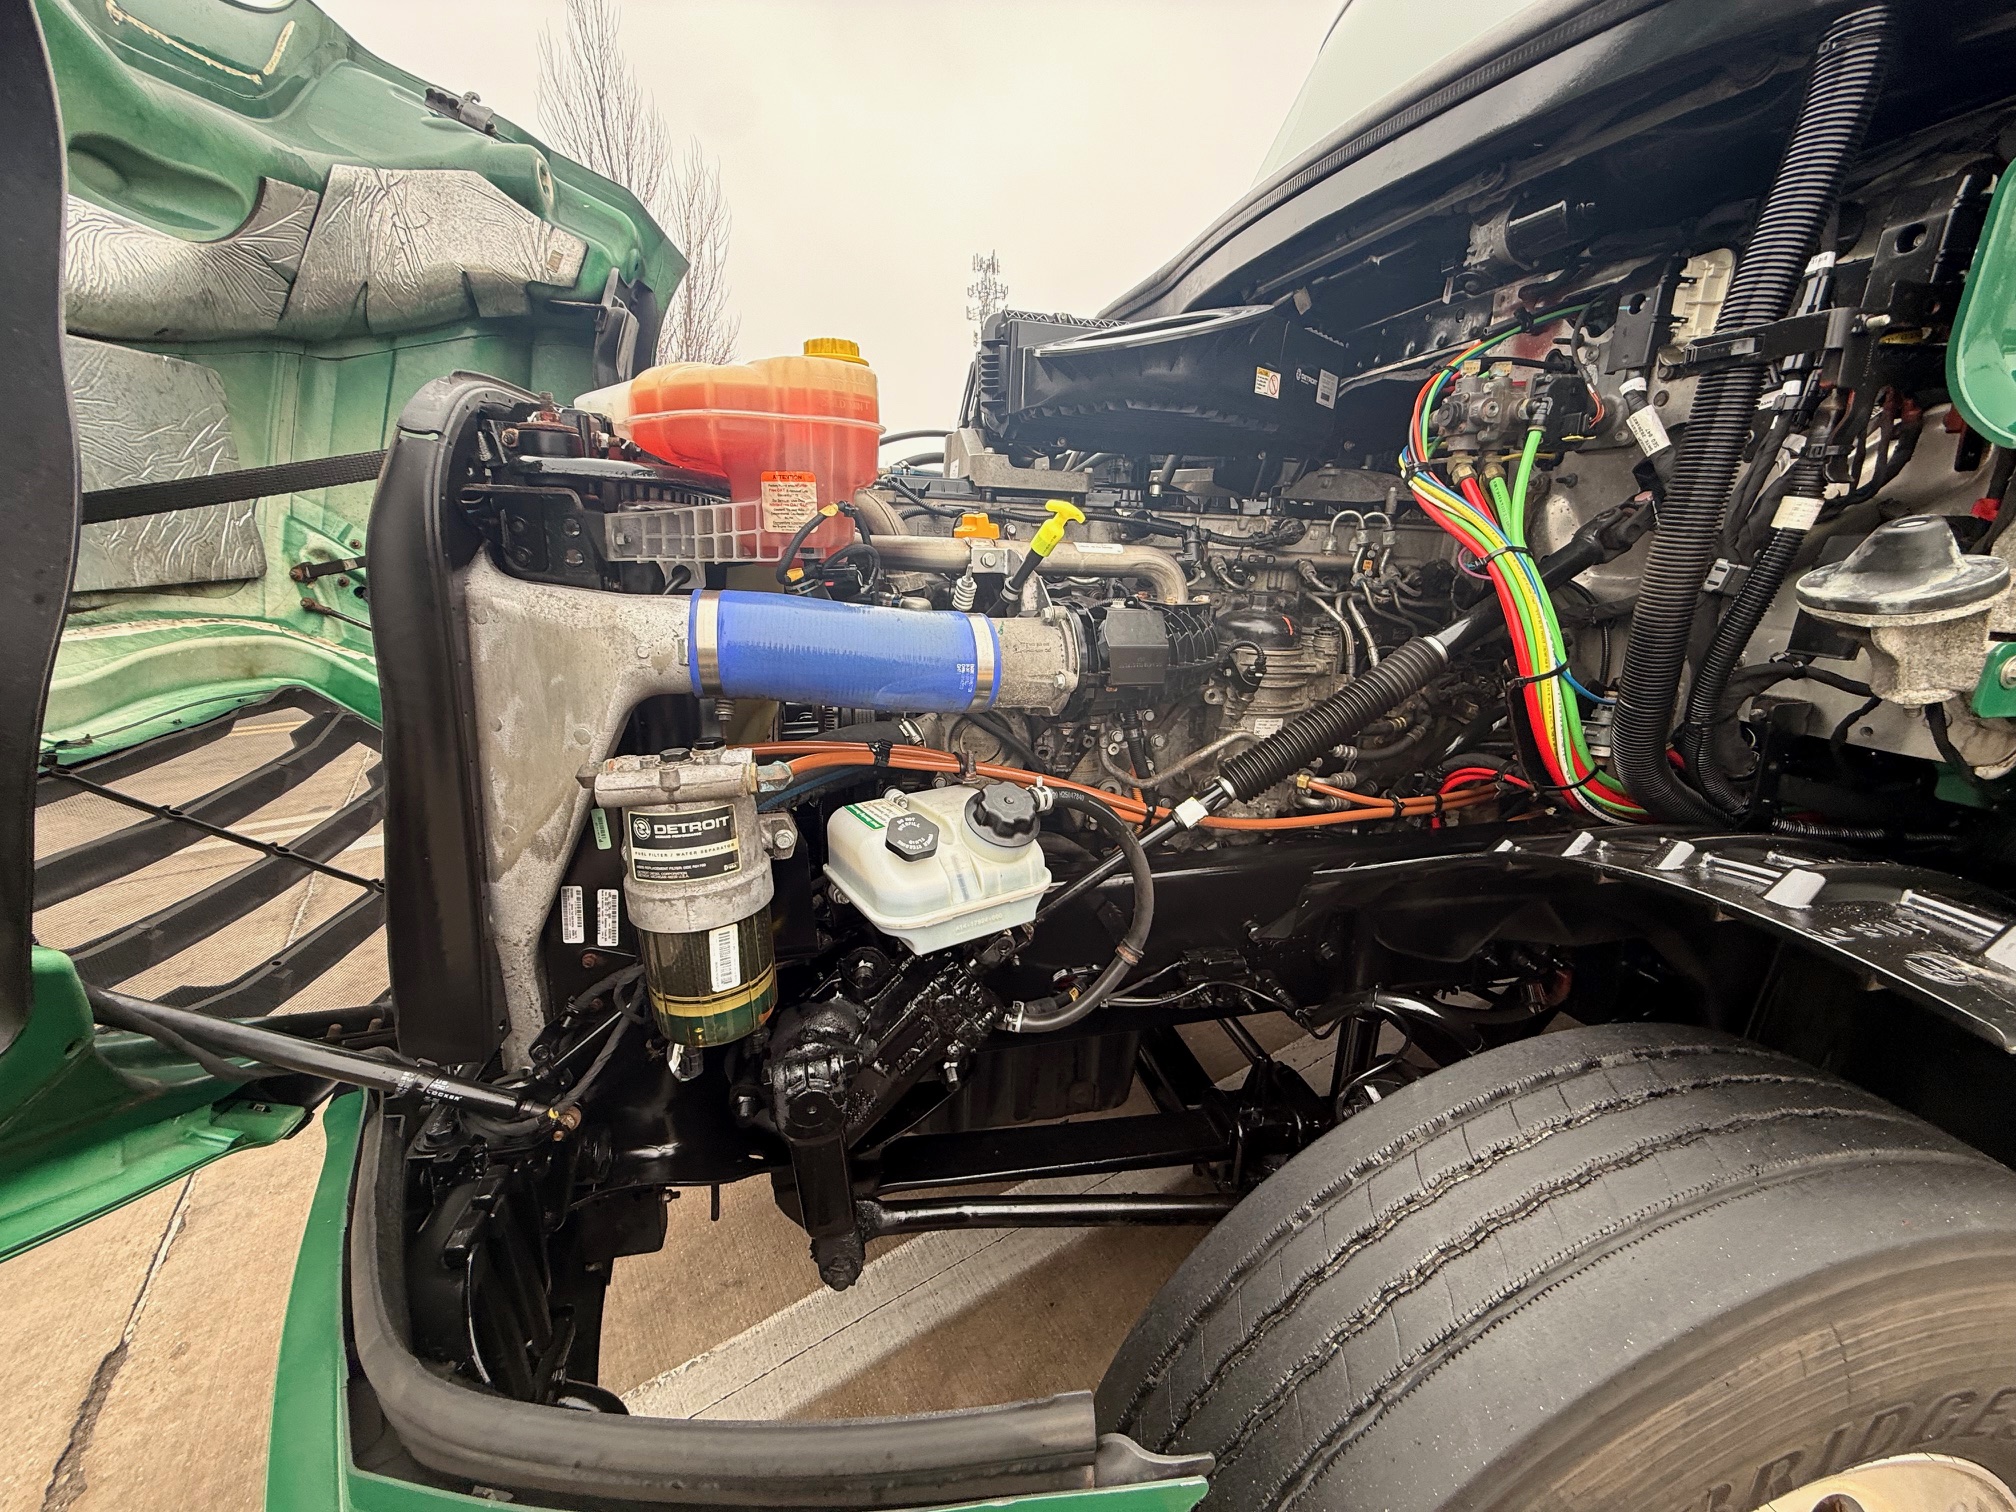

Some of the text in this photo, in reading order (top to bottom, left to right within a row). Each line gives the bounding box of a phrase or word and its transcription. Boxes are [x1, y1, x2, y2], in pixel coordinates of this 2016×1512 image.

[653, 816, 730, 835] DETROIT
[700, 842, 735, 854] SEPARATOR
[1700, 1384, 2016, 1512] BRIDGE
